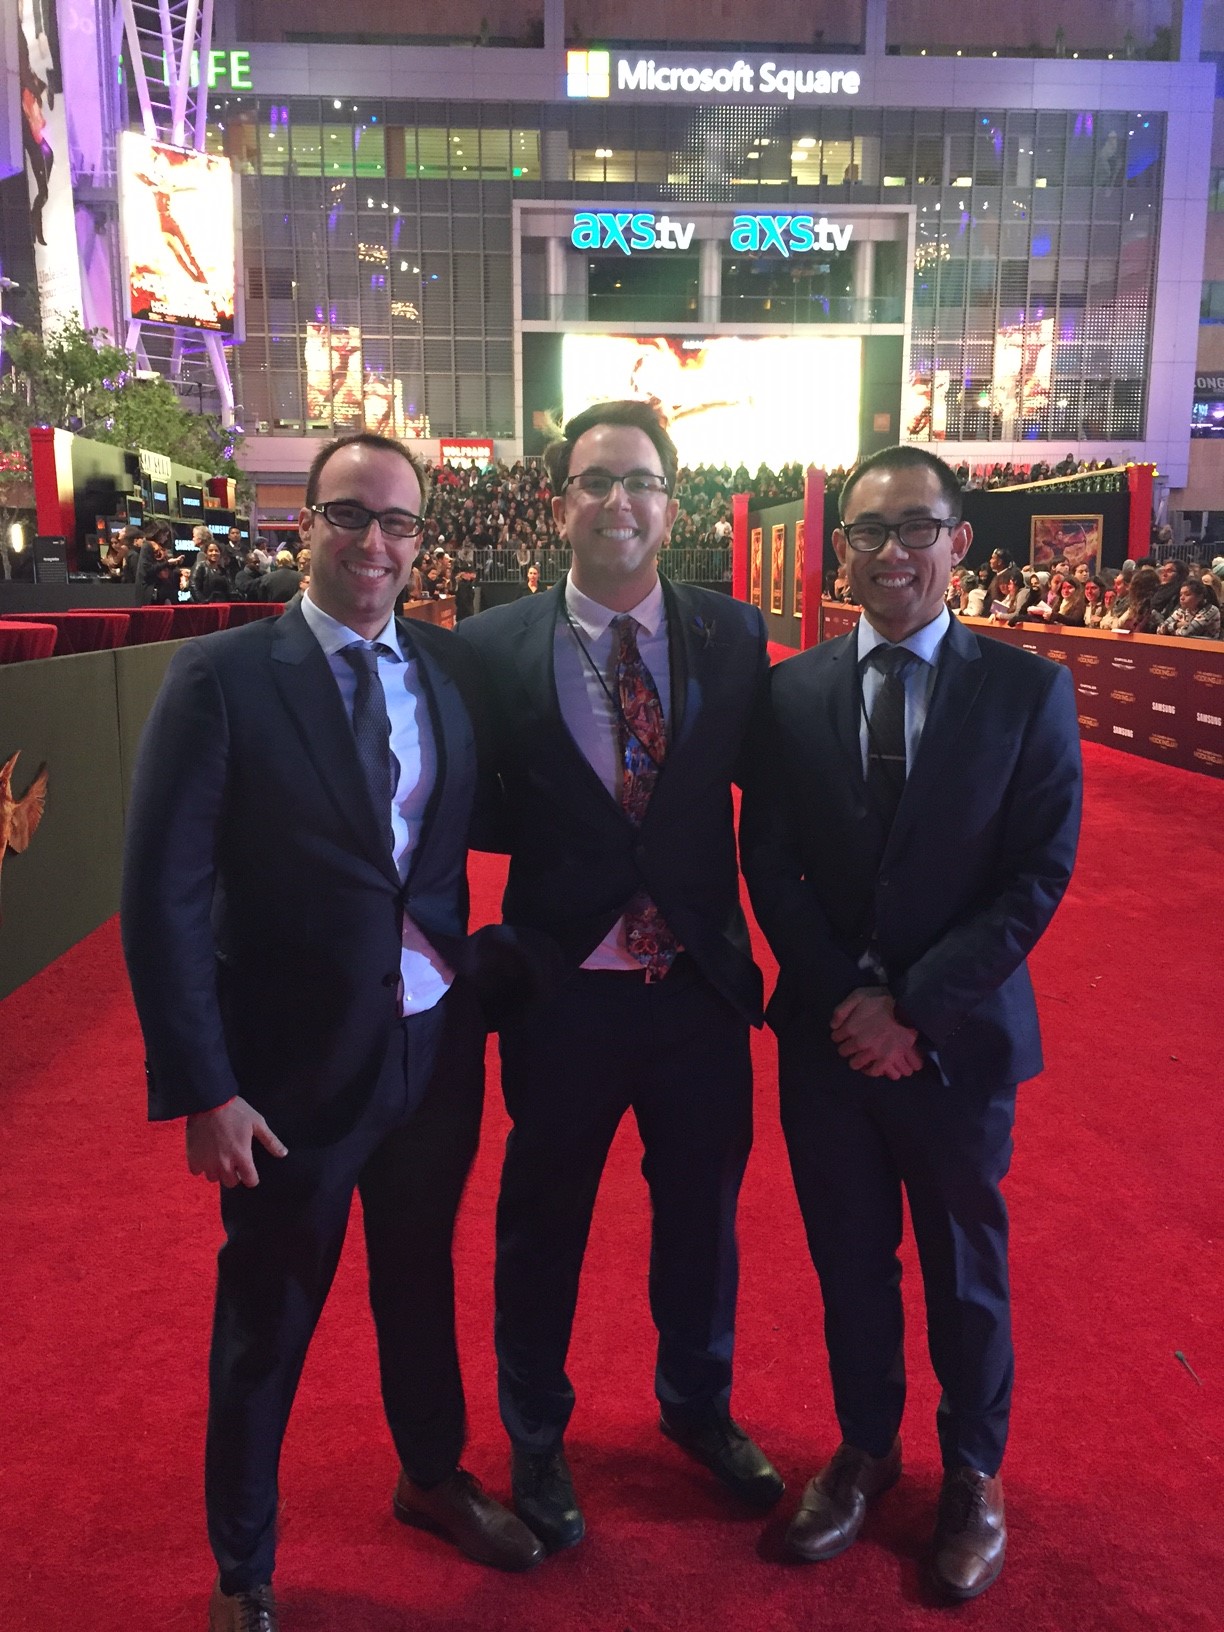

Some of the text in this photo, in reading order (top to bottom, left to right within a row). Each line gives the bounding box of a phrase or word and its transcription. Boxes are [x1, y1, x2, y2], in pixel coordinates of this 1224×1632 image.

[617, 60, 861, 100] Microsoft Square
[1151, 701, 1176, 715] SAMSUNG
[1196, 712, 1222, 727] SAMSUNG
[1112, 725, 1134, 739] SAMSUNG
